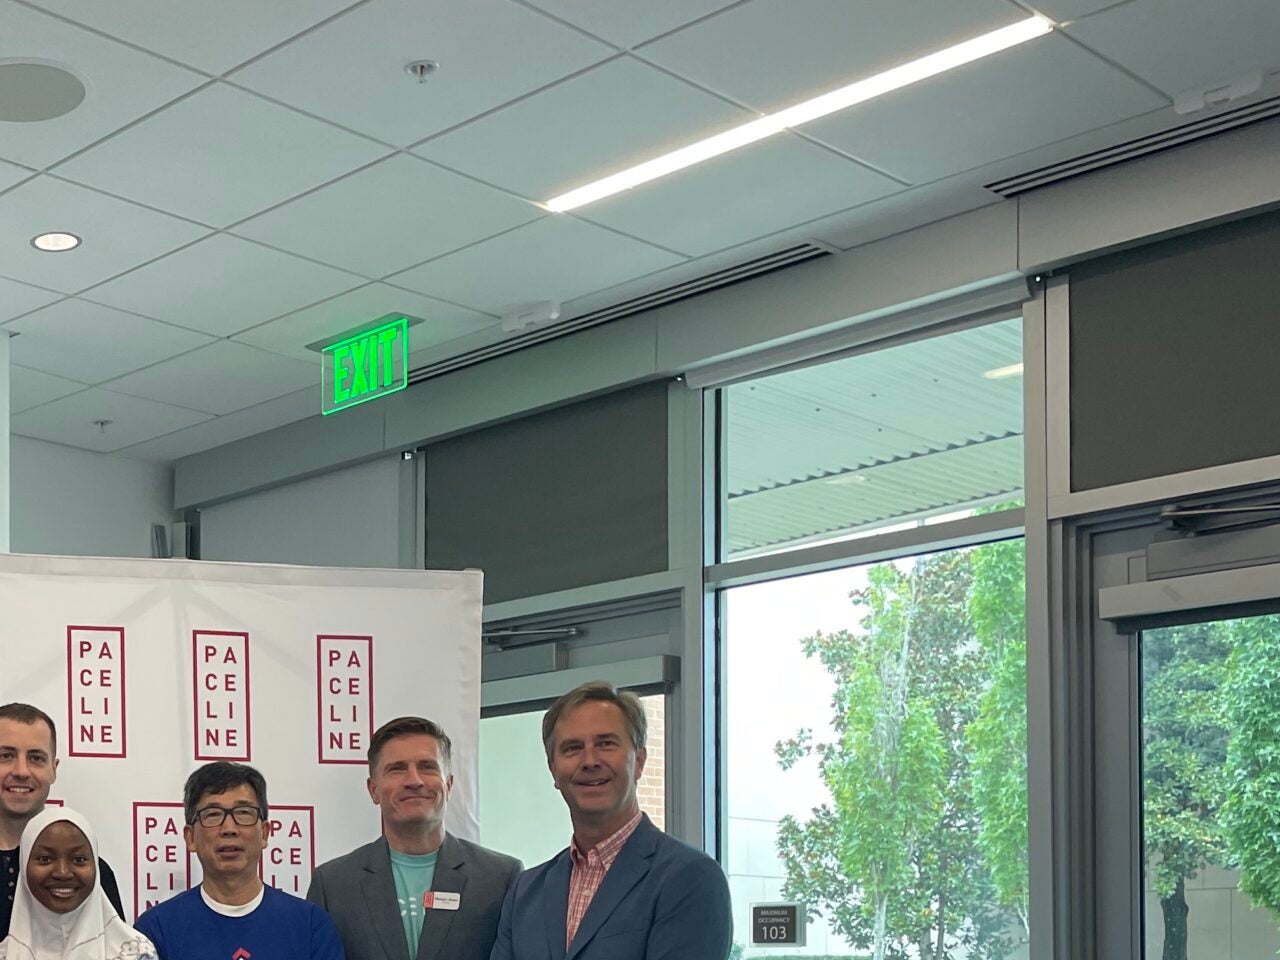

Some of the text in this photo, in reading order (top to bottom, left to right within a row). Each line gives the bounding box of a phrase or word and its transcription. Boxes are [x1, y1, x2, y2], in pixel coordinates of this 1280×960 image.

[334, 328, 397, 404] EXIT
[79, 640, 113, 660] PA
[204, 645, 237, 664] PA
[328, 649, 361, 668] PA
[79, 668, 112, 688] CE
[204, 673, 237, 692] CE
[328, 677, 360, 696] CE
[80, 697, 109, 715] LI
[205, 700, 234, 720] LI
[329, 704, 357, 723] LI
[80, 724, 113, 743] NE
[205, 728, 238, 747] NE
[329, 732, 361, 750] NE
[145, 816, 178, 836] PA
[145, 844, 178, 863] CE
[269, 847, 302, 866] CE
[762, 926, 786, 940] 103
